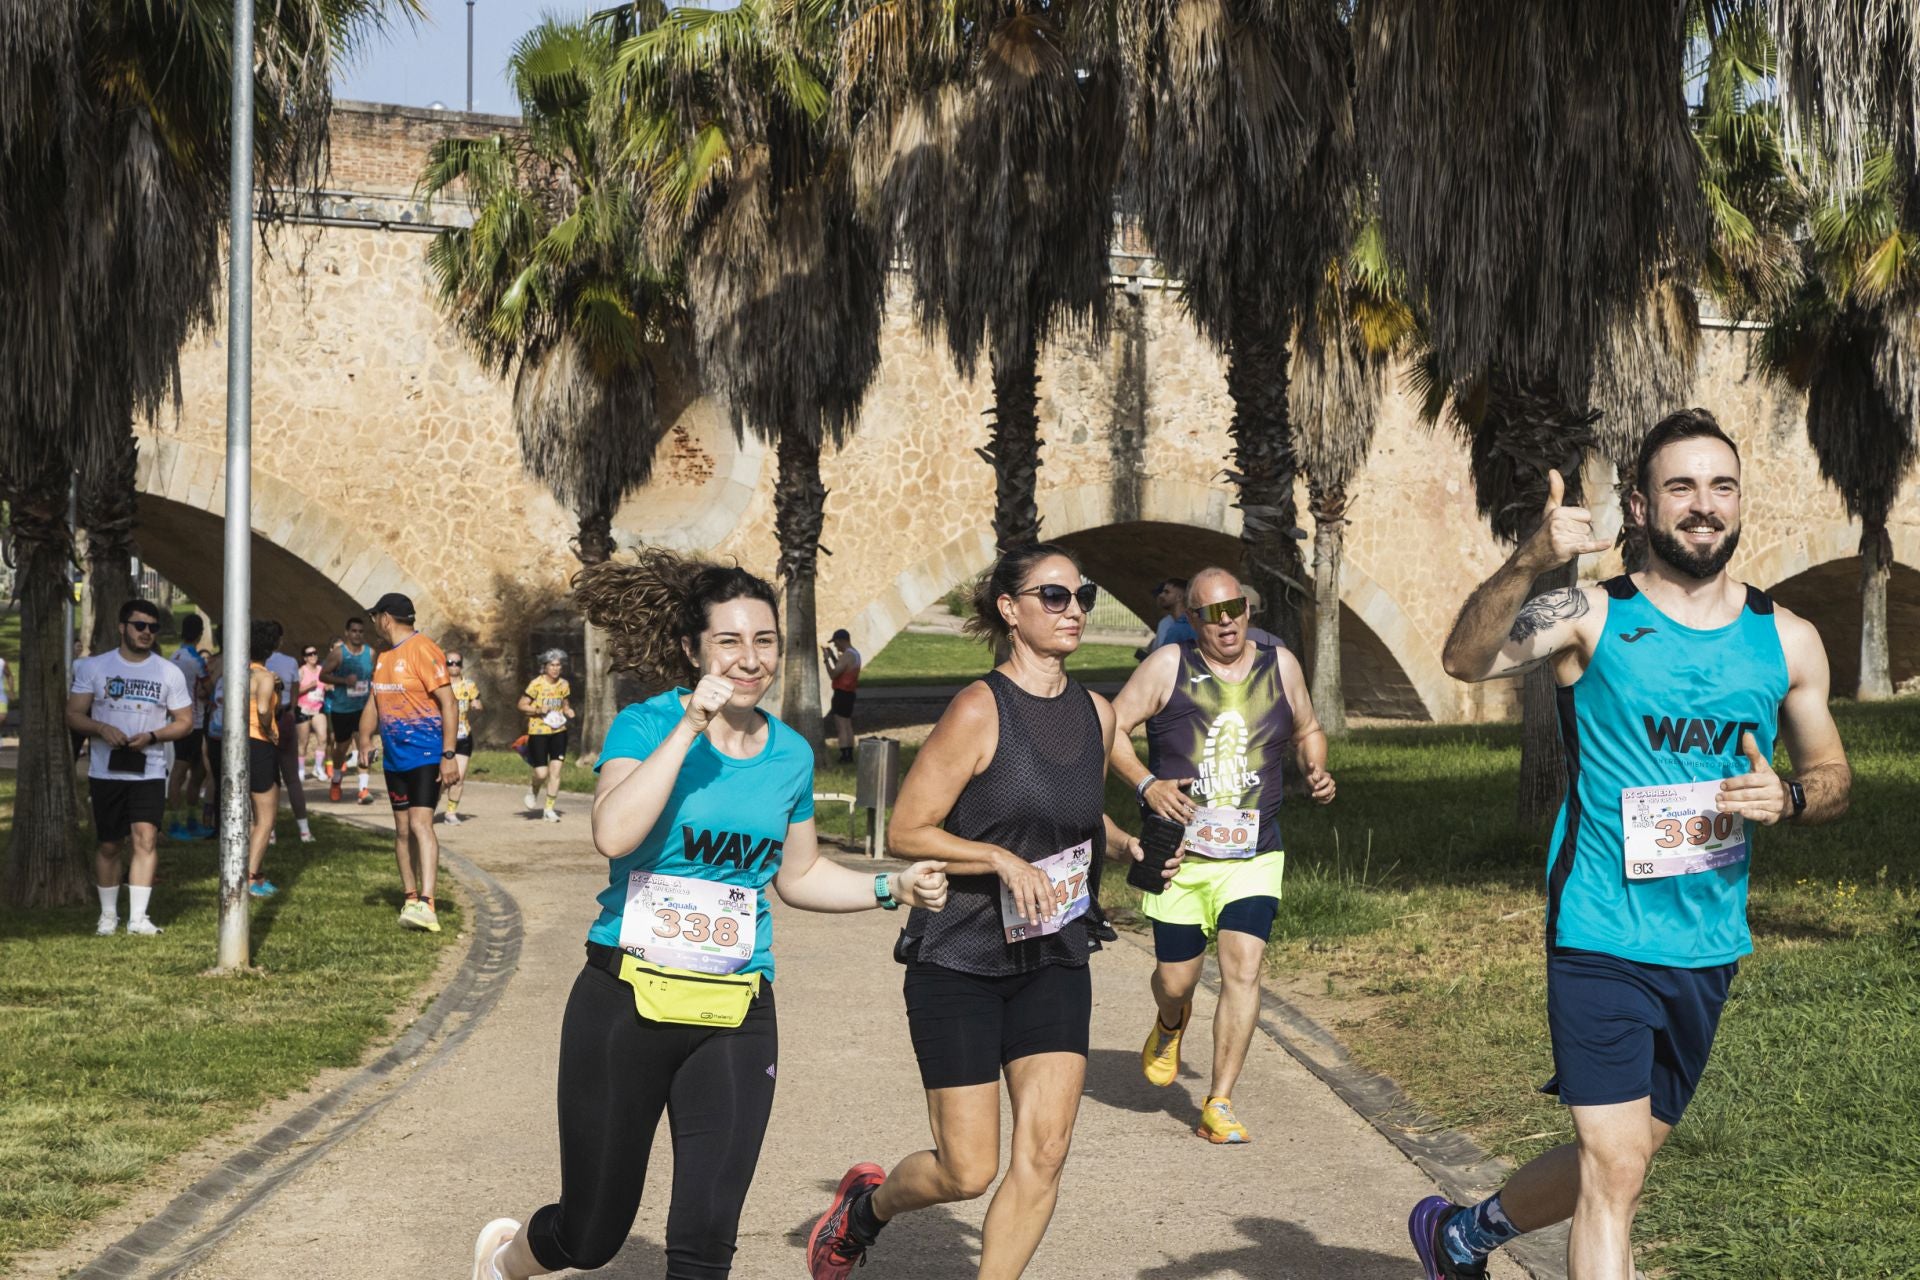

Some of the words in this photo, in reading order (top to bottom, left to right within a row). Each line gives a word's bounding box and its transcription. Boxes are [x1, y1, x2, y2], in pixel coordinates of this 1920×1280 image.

[126, 682, 161, 693] LINHAS
[136, 690, 160, 700] ELVAS
[1198, 754, 1249, 778] HEAVY
[1191, 769, 1261, 797] RUNNERS
[1666, 808, 1697, 818] aqualia
[1197, 825, 1248, 845] 430
[1655, 812, 1734, 849] 390
[1633, 862, 1653, 874] 5K
[667, 901, 698, 911] aqualia
[651, 908, 739, 947] 338
[1010, 927, 1026, 938] 5K
